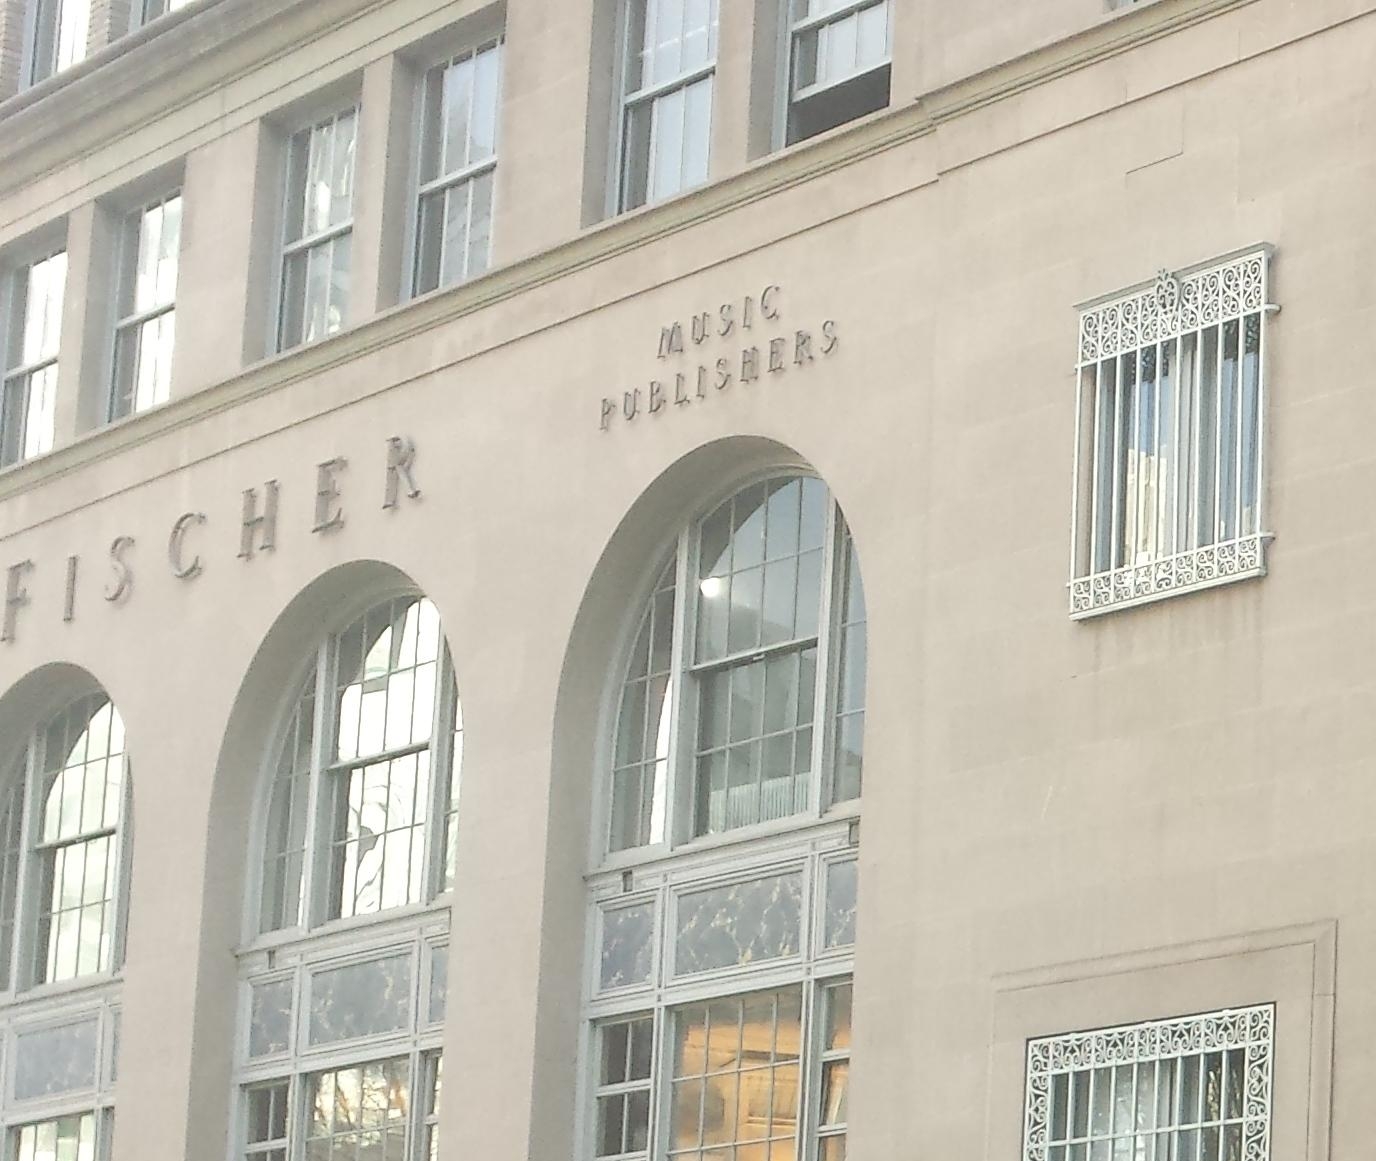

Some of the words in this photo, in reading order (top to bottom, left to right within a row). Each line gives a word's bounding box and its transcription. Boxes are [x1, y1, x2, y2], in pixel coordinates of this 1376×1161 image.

[599, 319, 839, 431] PUBLISHERS
[656, 284, 781, 360] MUSIC
[0, 436, 422, 644] FISCHER
